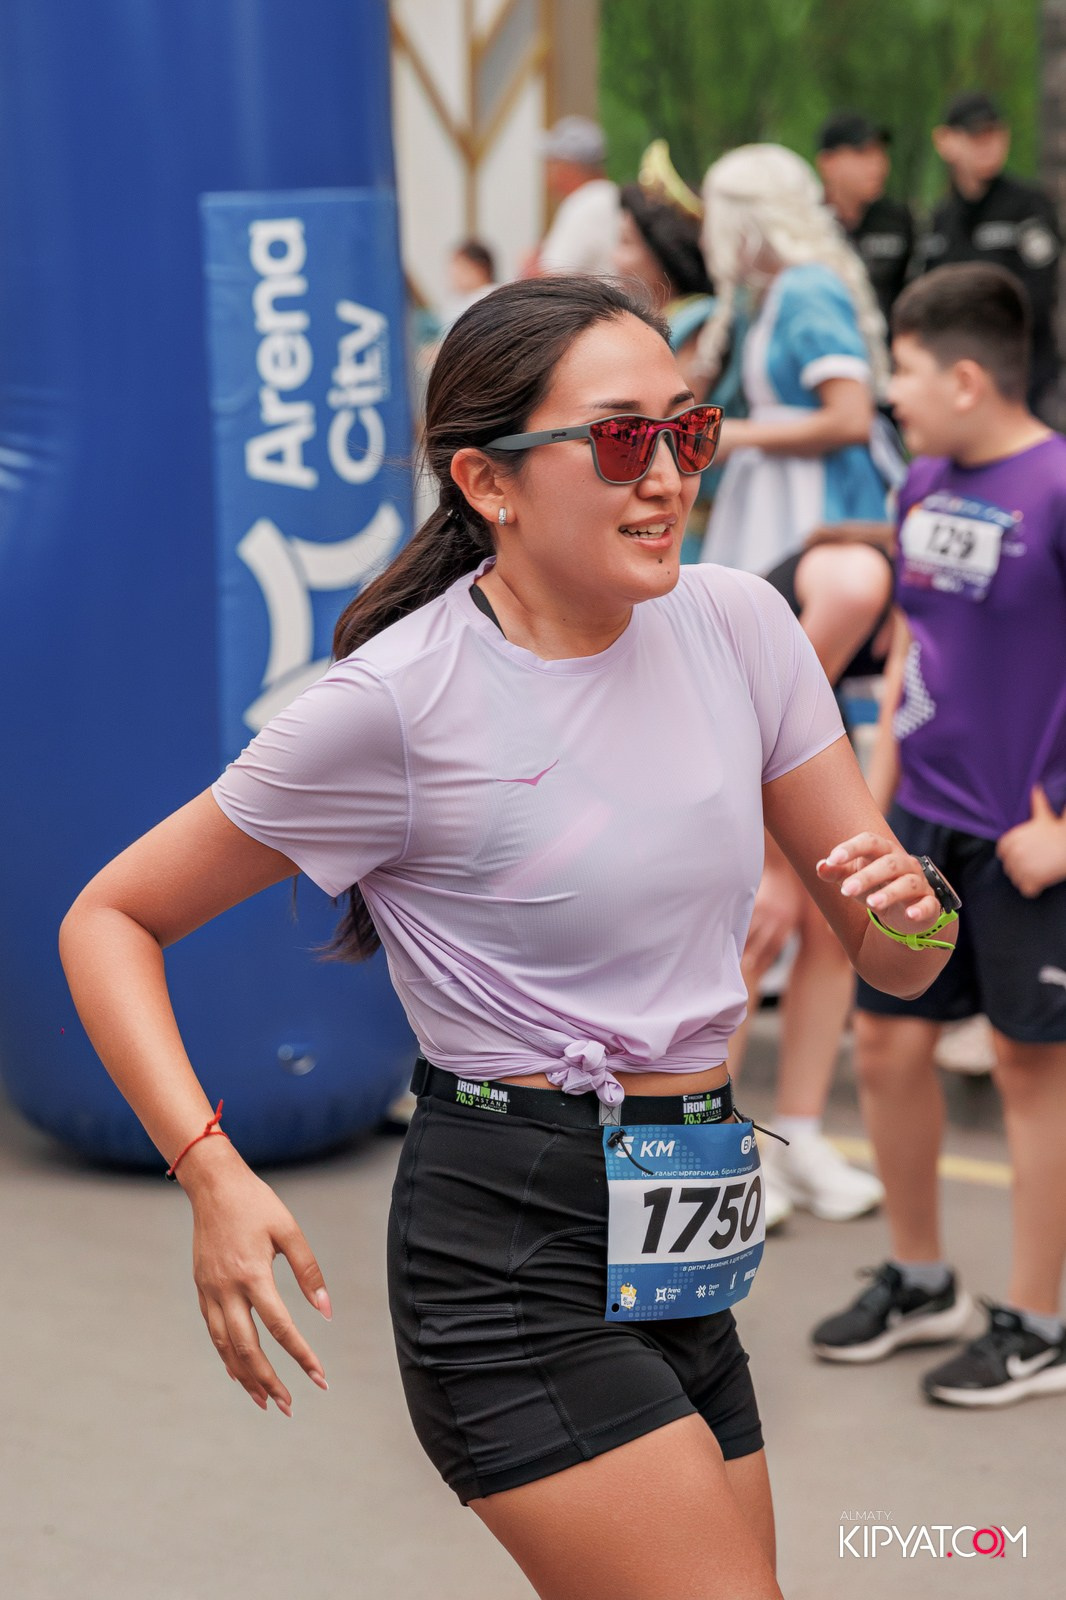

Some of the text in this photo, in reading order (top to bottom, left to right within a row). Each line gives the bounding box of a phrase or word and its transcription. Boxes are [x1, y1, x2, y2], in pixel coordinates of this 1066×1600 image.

[245, 217, 319, 490] Arena
[327, 300, 388, 485] City
[456, 1091, 474, 1106] 70.3
[457, 1080, 509, 1103] IRONMAN
[683, 1095, 722, 1113] IRONMAN
[683, 1113, 702, 1125] 70.3
[615, 1136, 676, 1158] 5 KM
[641, 1175, 762, 1254] 1750
[667, 1293, 676, 1301] City
